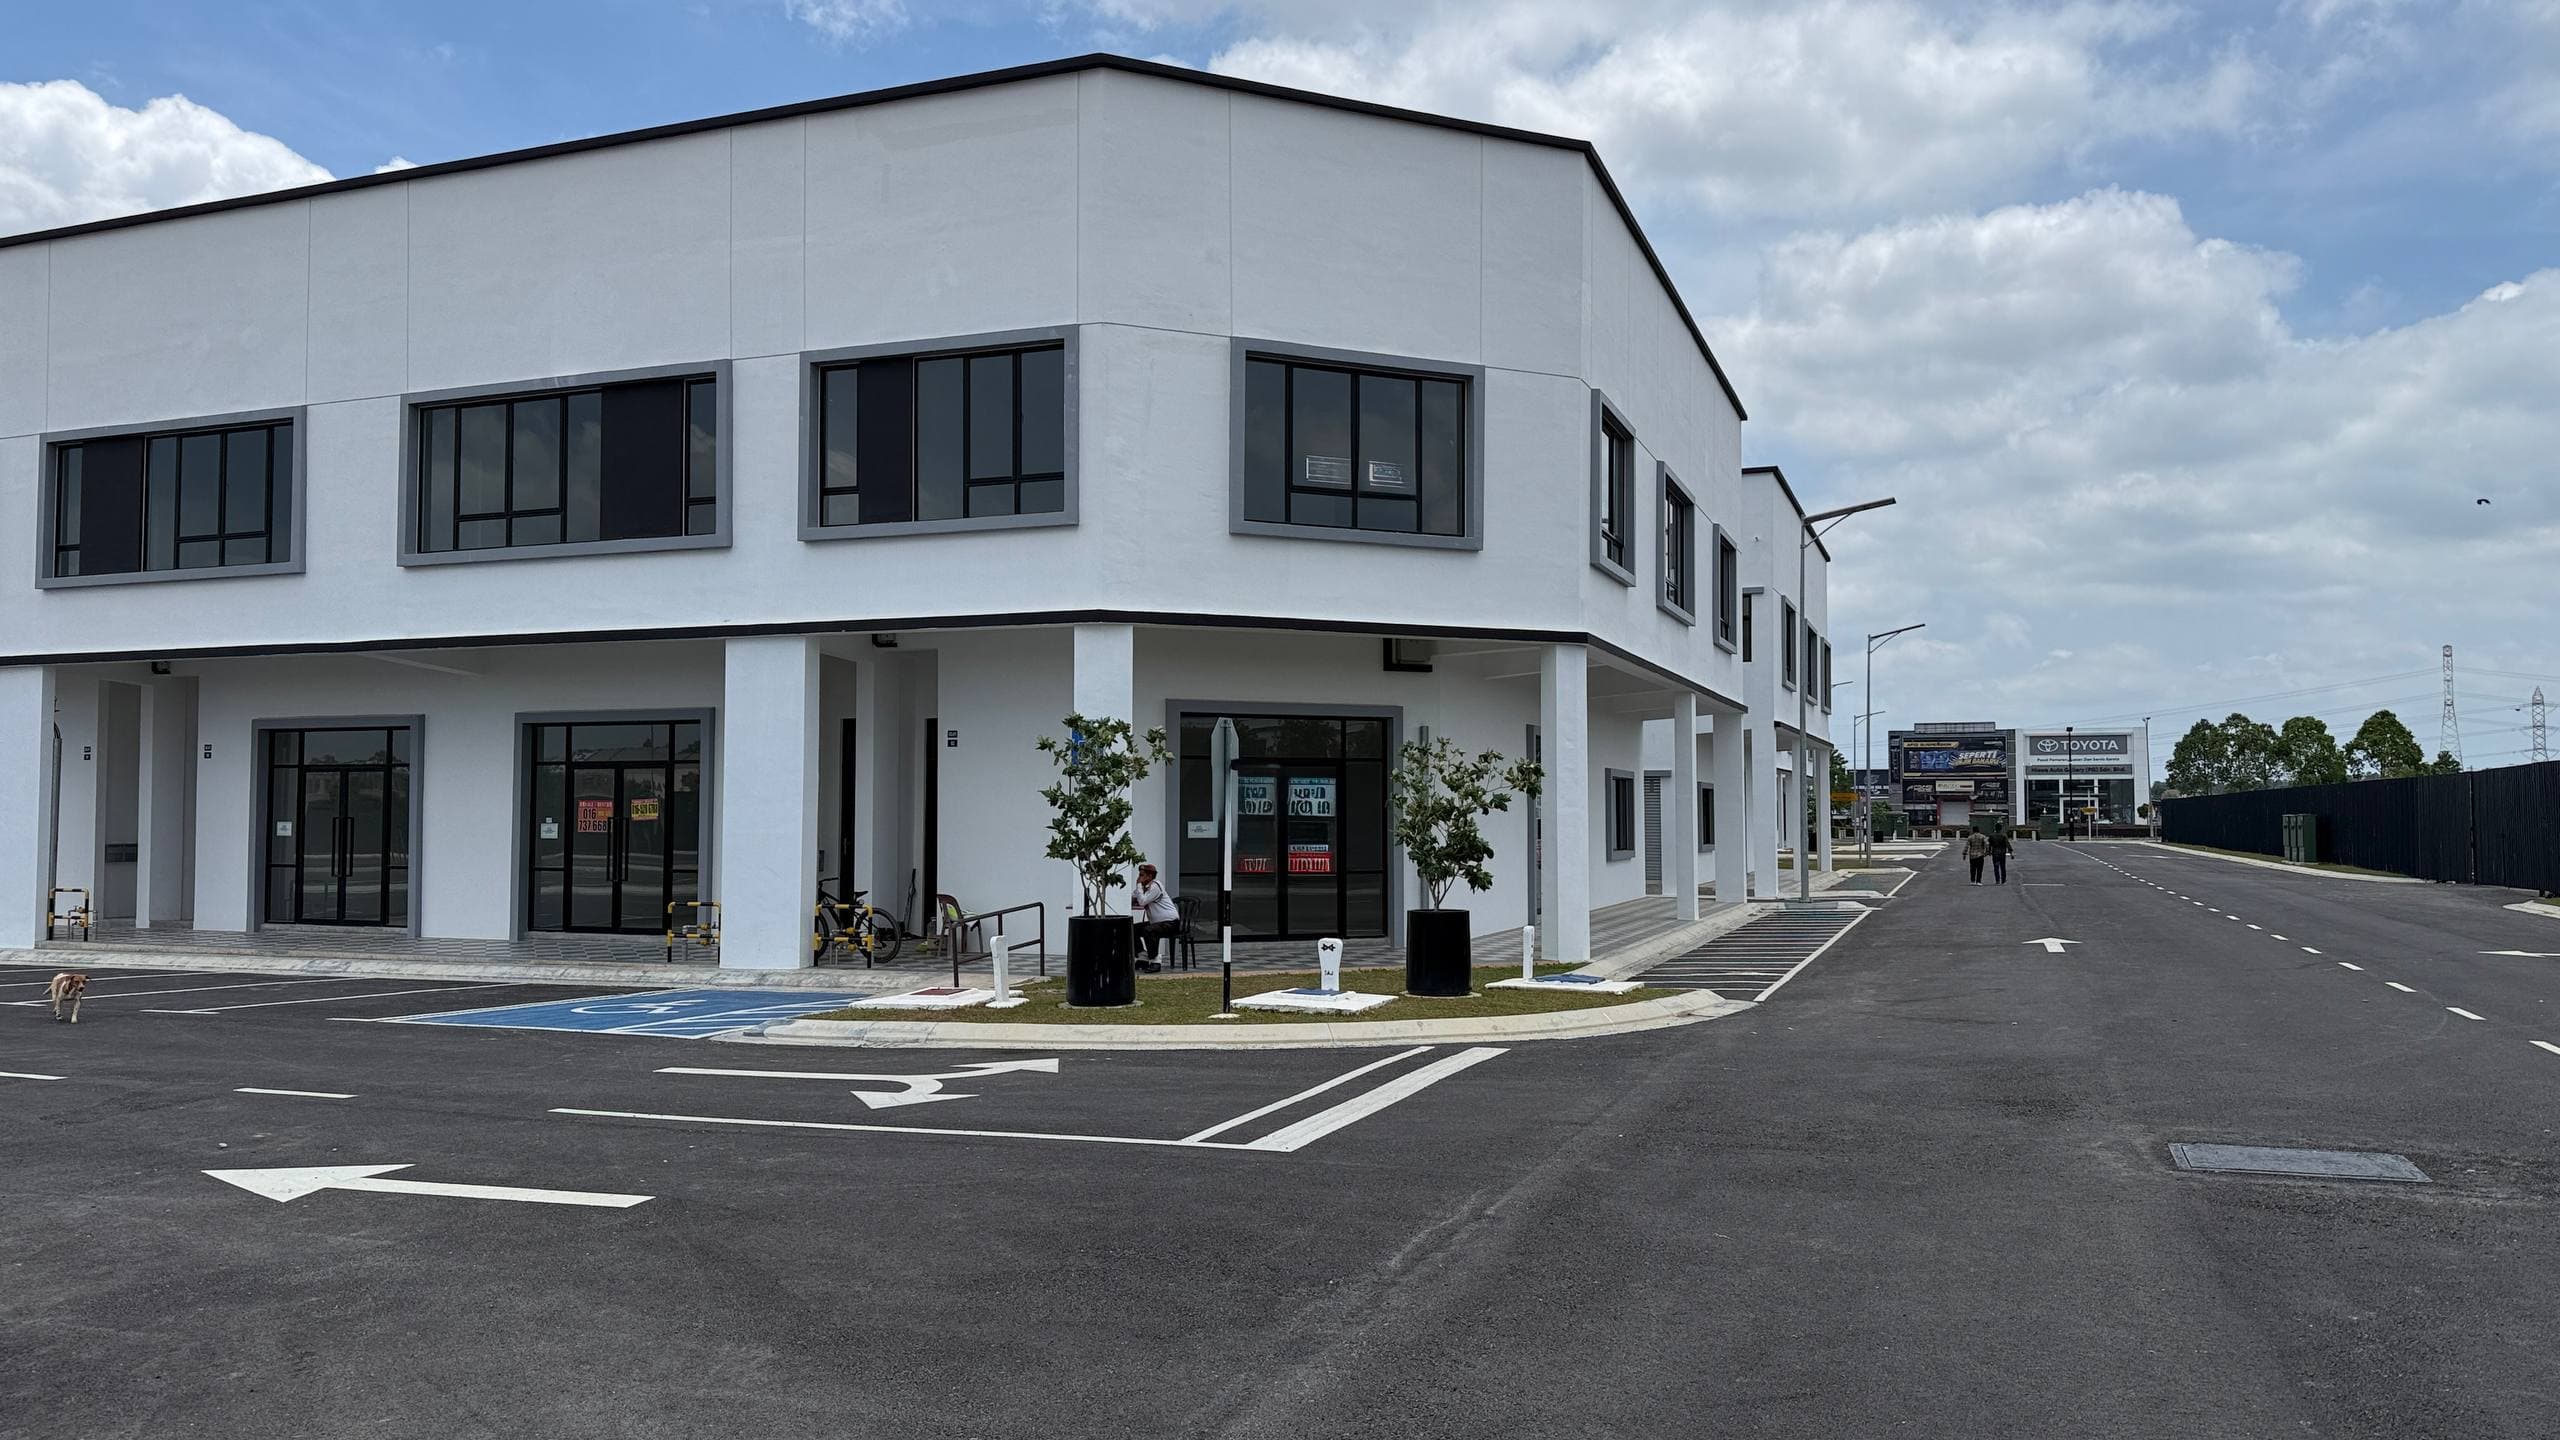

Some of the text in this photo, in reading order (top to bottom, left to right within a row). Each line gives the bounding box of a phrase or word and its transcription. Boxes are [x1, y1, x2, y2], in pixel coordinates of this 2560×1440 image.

[2060, 740, 2119, 750] TOYOTA
[1958, 750, 1997, 760] SEPERTI
[2064, 766, 2085, 774] Gllery
[583, 808, 597, 820] 016
